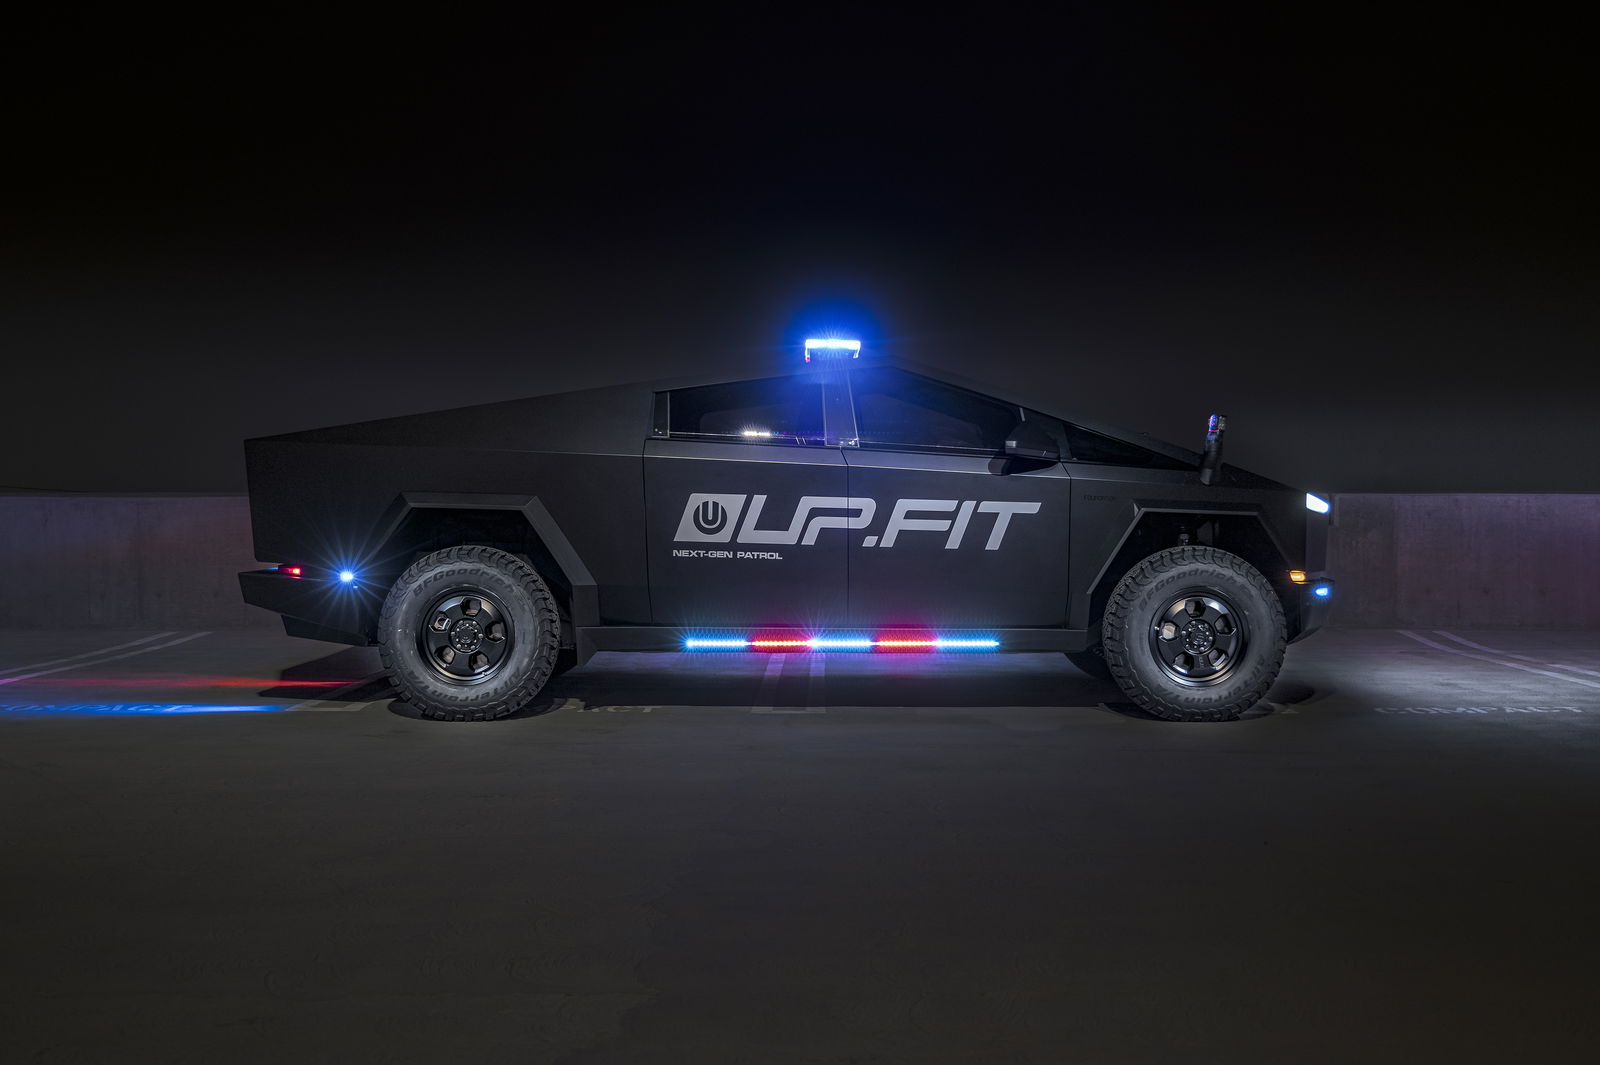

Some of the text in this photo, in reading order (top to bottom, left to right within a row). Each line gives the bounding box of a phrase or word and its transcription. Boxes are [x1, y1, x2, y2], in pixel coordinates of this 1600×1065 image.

[737, 494, 1042, 550] UP.FIT
[673, 550, 783, 561] NEXT-GEN PATROL
[413, 568, 515, 596] BFGoodrich
[1138, 567, 1237, 611] BFGoodrich
